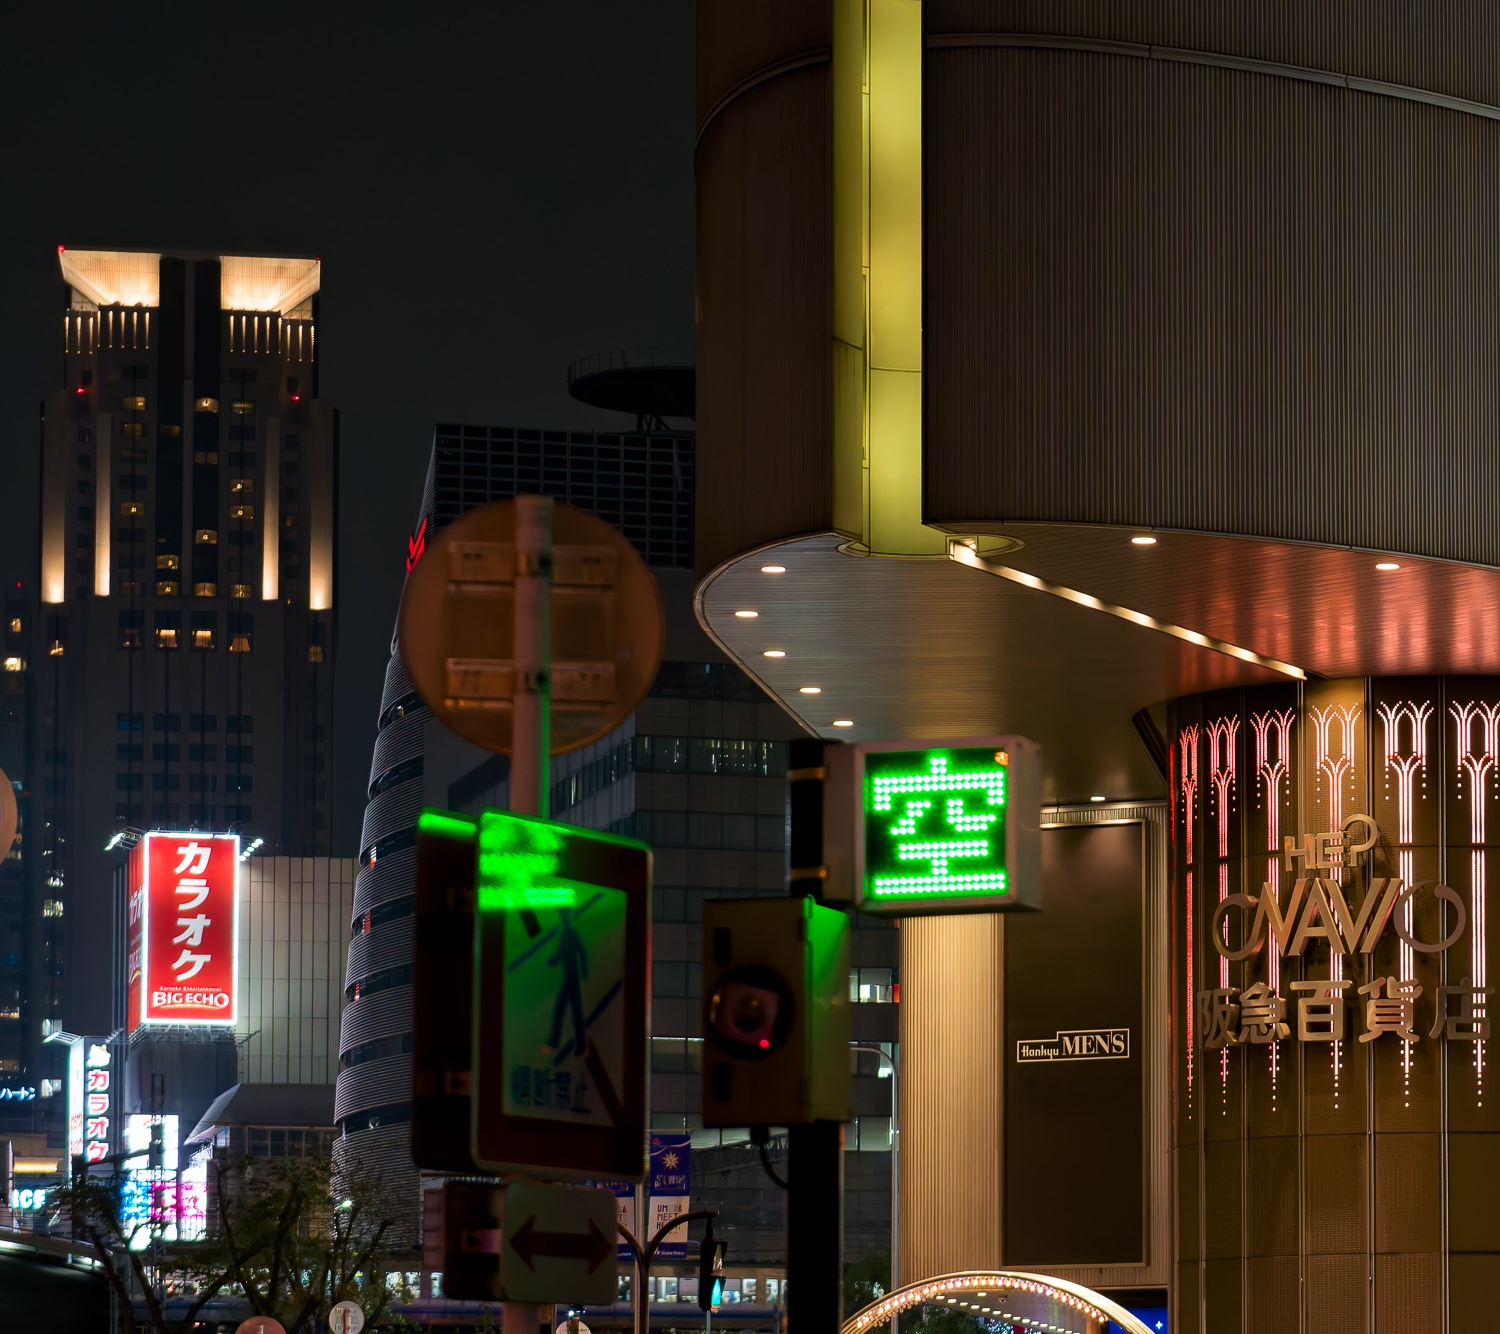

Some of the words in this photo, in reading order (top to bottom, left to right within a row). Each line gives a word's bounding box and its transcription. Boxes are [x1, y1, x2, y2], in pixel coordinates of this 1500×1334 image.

[873, 756, 1005, 895] 空
[1284, 813, 1380, 871] HEP
[172, 841, 212, 981] カラオケ
[1212, 877, 1466, 961] NAVIO
[152, 991, 183, 1007] BIG
[185, 992, 230, 1009] ECHO
[1197, 976, 1495, 1049] 阪急百貨店
[1021, 1045, 1059, 1059] Hankyu
[1062, 1030, 1125, 1055] MEN'S
[88, 1069, 109, 1163] カラオケ
